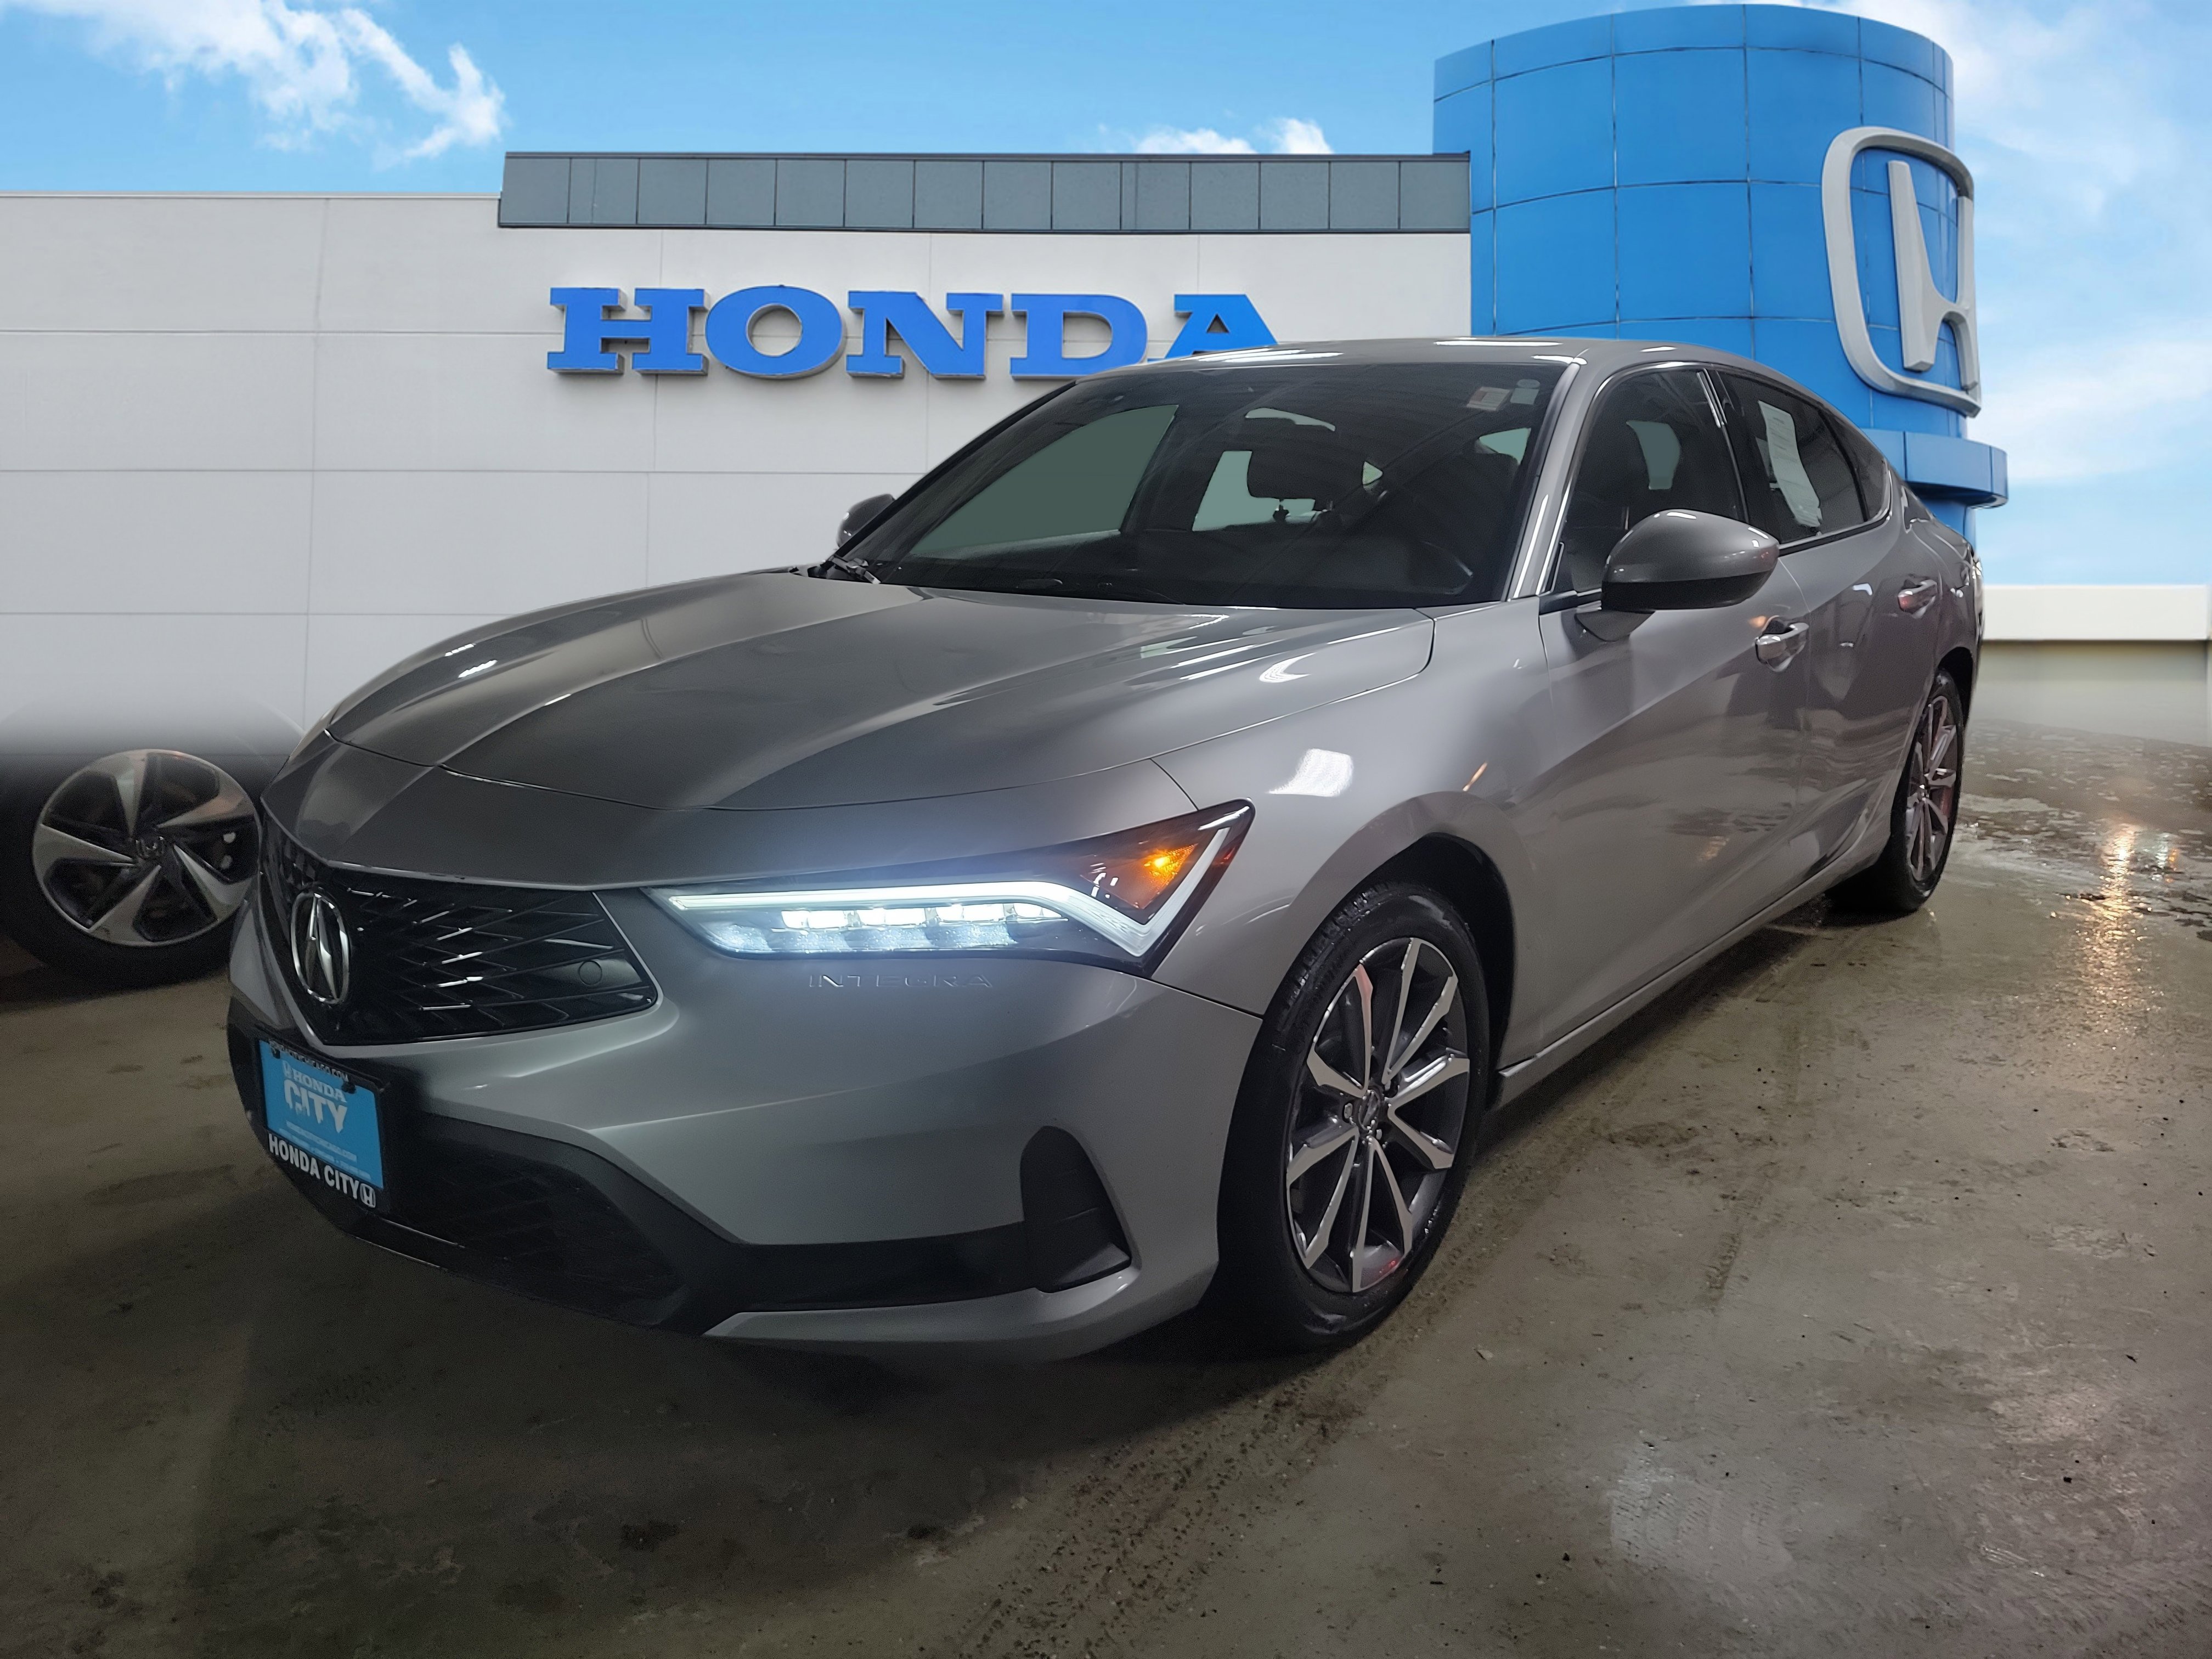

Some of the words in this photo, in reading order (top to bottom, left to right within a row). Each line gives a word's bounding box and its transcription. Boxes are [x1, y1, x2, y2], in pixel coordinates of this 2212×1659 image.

[548, 285, 1279, 380] HONDA
[809, 974, 993, 988] INTEGRA
[284, 1079, 348, 1133] CITY
[291, 1067, 347, 1103] HONDA
[268, 1133, 320, 1180] HONDA
[324, 1165, 360, 1200] CITY
